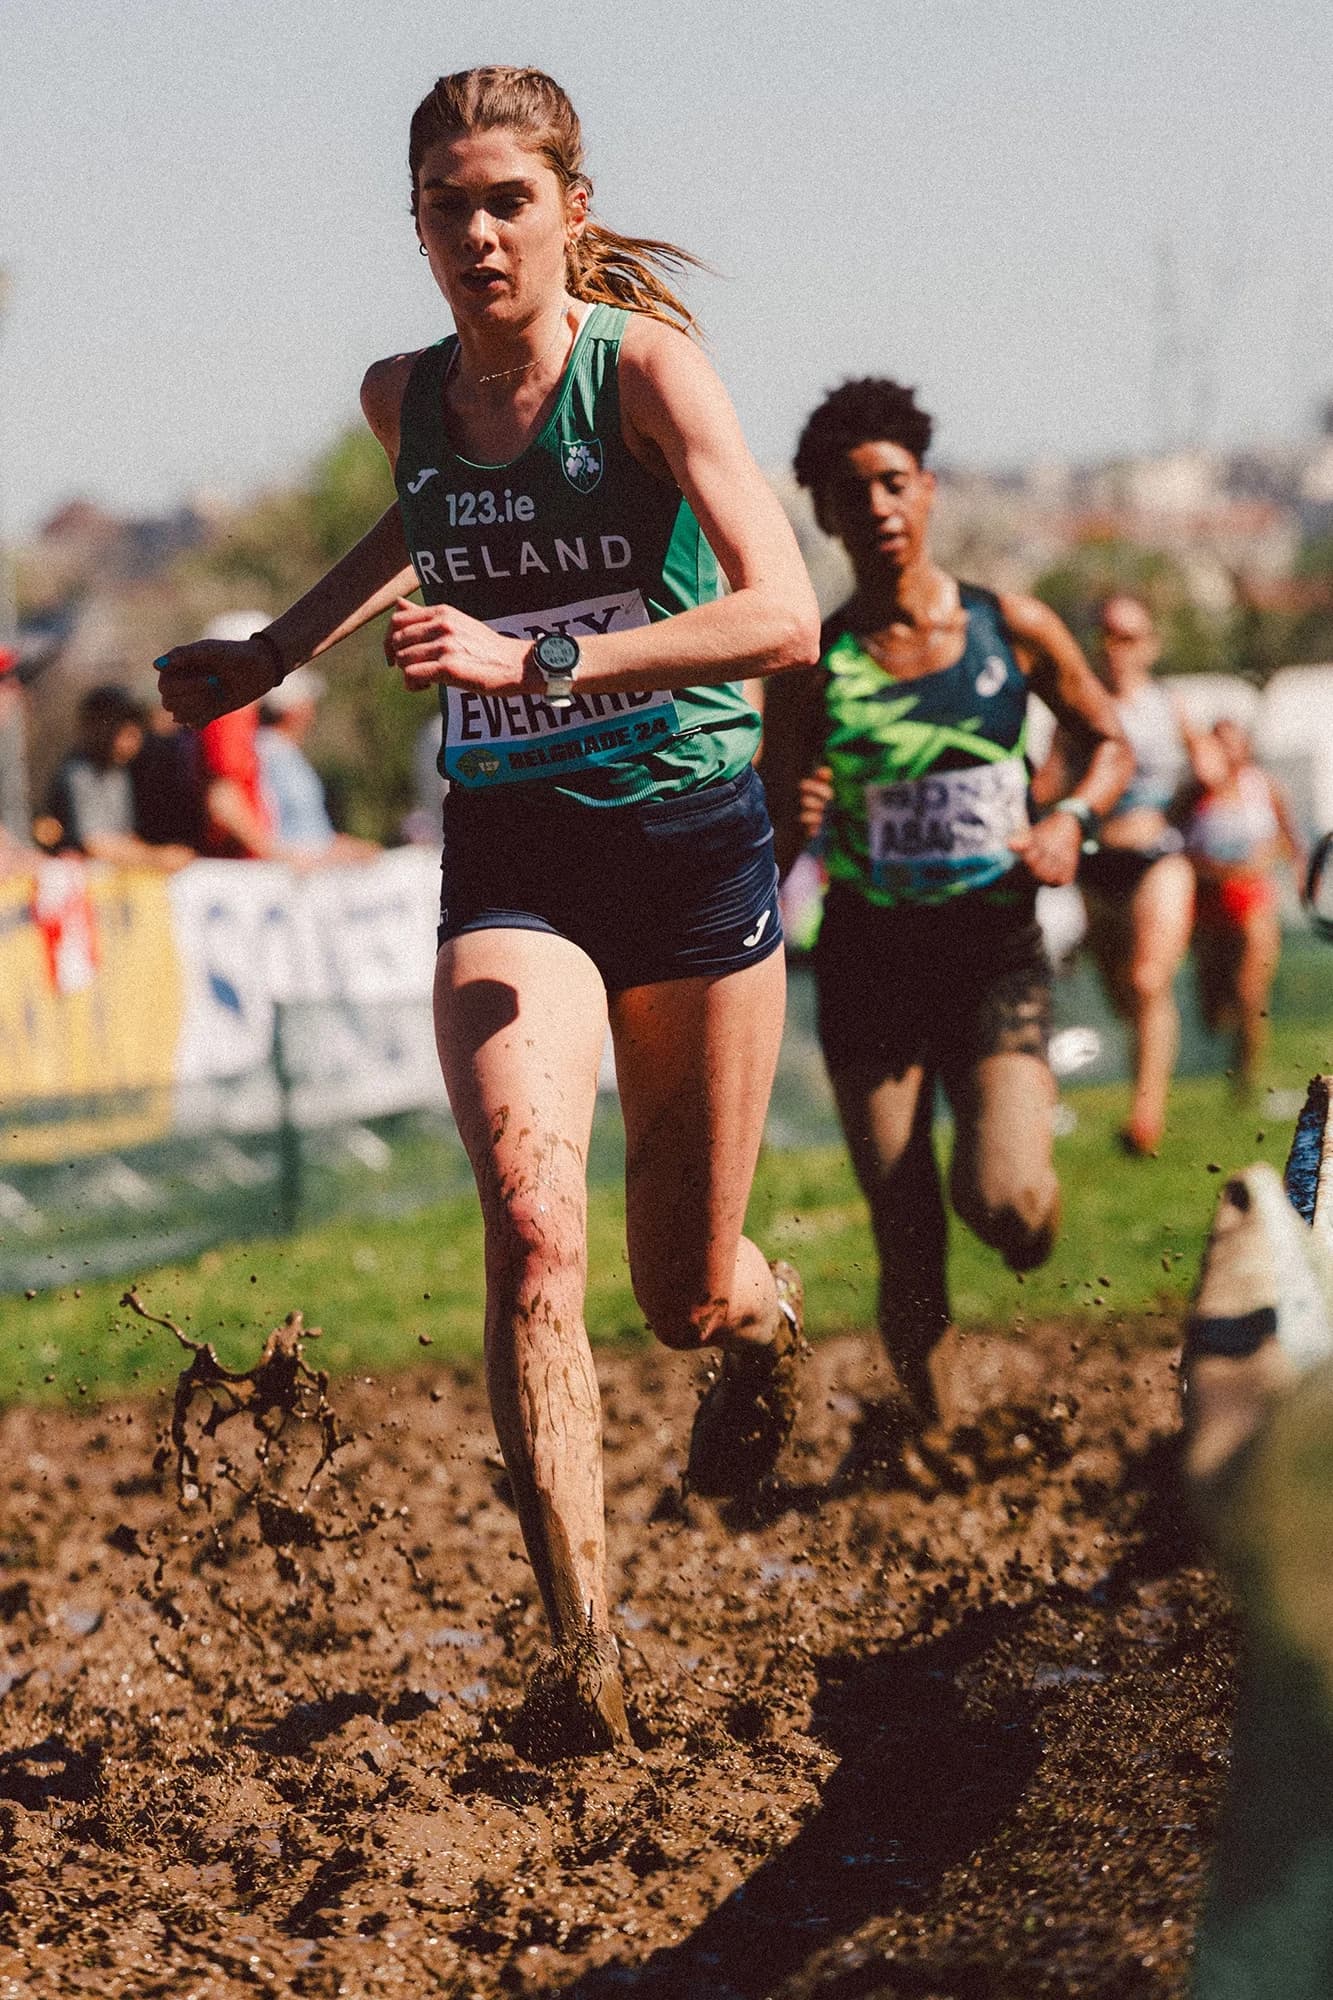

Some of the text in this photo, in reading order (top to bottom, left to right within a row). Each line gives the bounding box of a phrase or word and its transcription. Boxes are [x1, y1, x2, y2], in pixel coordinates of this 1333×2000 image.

[445, 488, 536, 527] 123.ie
[410, 534, 632, 585] RELAND
[508, 716, 670, 770] BELGRADE 24
